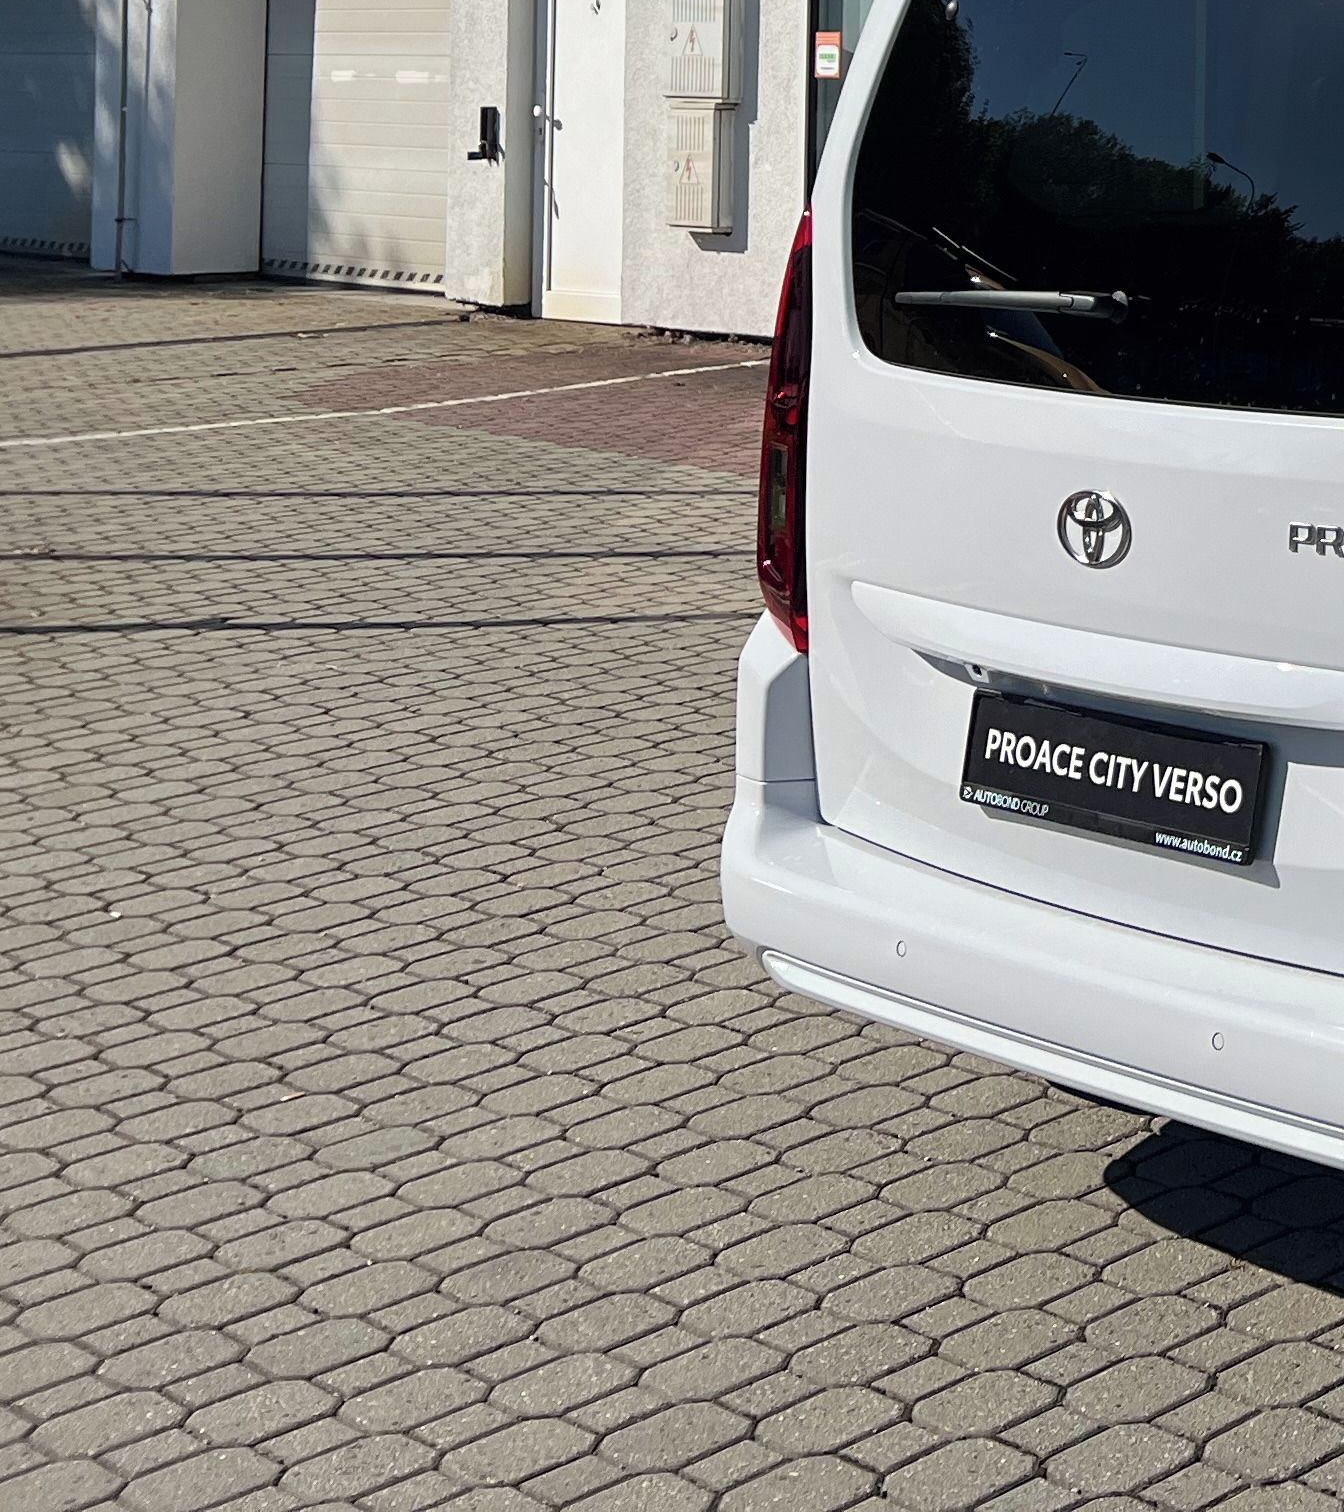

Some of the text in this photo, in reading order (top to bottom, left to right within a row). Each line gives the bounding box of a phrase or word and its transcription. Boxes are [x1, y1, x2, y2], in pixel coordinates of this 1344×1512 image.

[984, 728, 1243, 814] PROACE CITY VERSO
[973, 789, 1021, 810] AUTOBOND
[1155, 832, 1243, 862] www.autobond.cz
